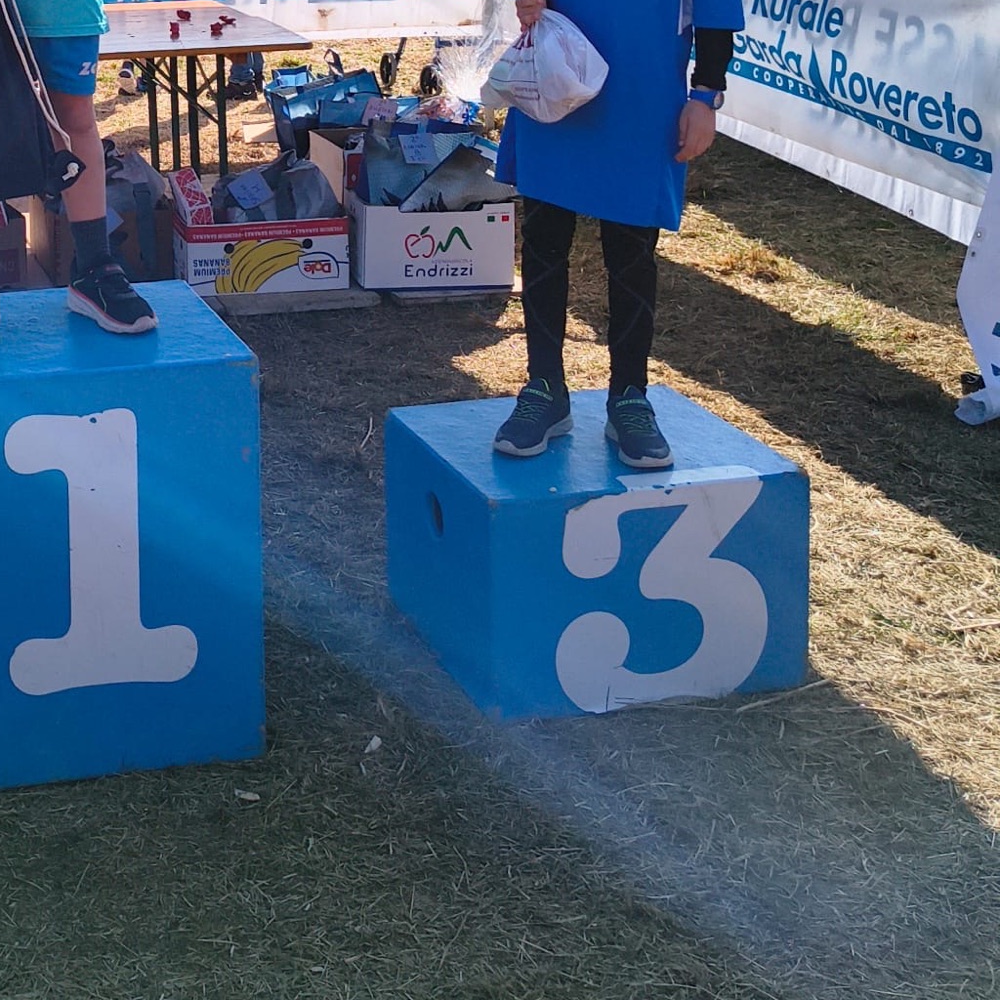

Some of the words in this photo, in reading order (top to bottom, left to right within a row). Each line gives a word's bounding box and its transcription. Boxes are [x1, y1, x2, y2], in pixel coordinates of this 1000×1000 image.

[829, 49, 983, 143] Rovereto
[192, 259, 230, 267] BANANAS
[303, 262, 331, 273] Dole
[404, 263, 473, 278] Endrizzi
[193, 268, 230, 276] PREMIUM
[4, 407, 198, 696] 1
[555, 465, 768, 714] 3
